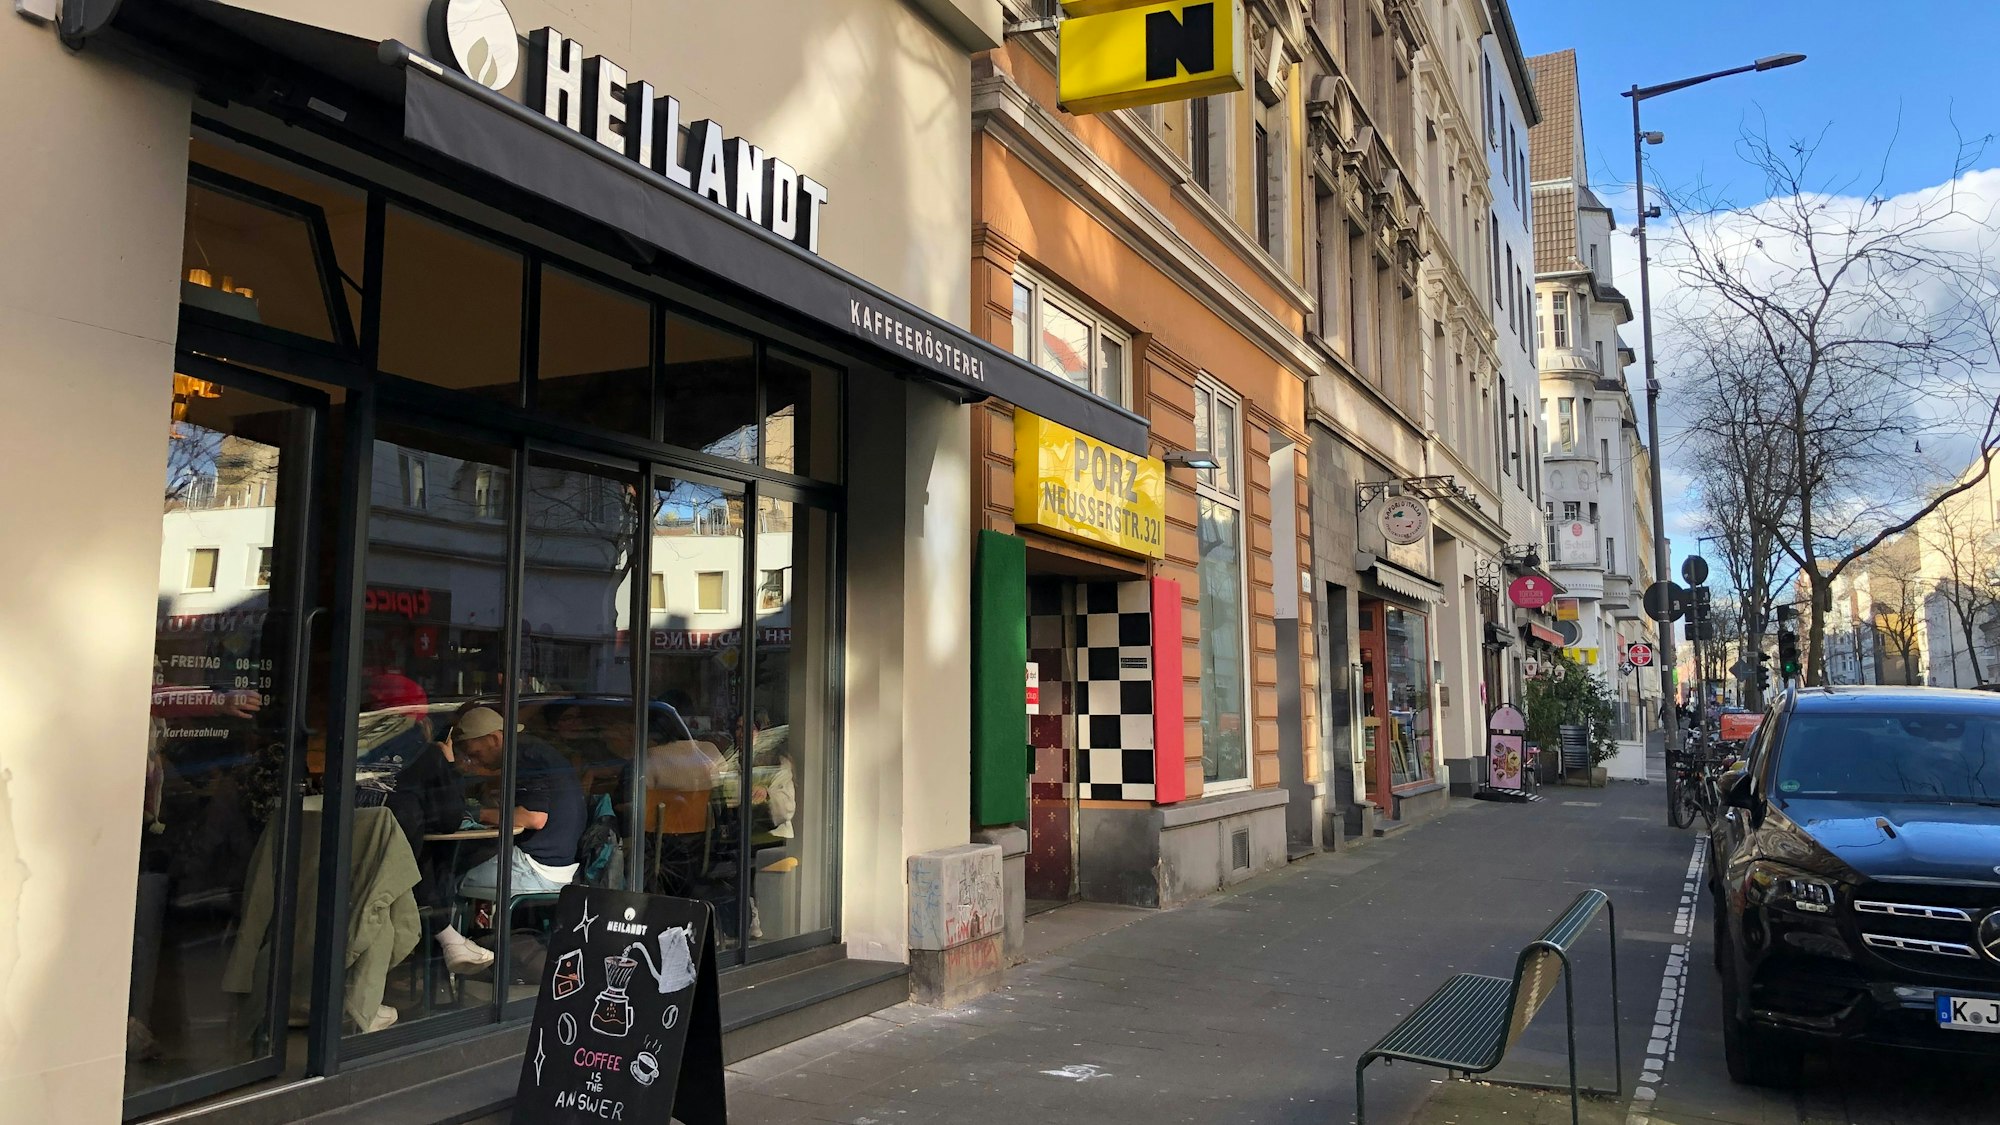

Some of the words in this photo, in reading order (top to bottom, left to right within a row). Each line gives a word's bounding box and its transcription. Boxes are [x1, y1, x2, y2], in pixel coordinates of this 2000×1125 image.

[1146, 2, 1214, 81] N
[531, 26, 828, 255] HEILANDT
[850, 299, 985, 382] KAFFEERÖSTEREI
[1074, 436, 1138, 504] PORZ
[170, 655, 221, 669] FREITAG
[168, 693, 225, 705] FEIERTAG
[163, 728, 230, 739] Kartenzahlung
[573, 1047, 623, 1072] COFFEE
[585, 1081, 604, 1093] THE
[591, 1072, 602, 1083] IS
[554, 1090, 625, 1121] ANSWER
